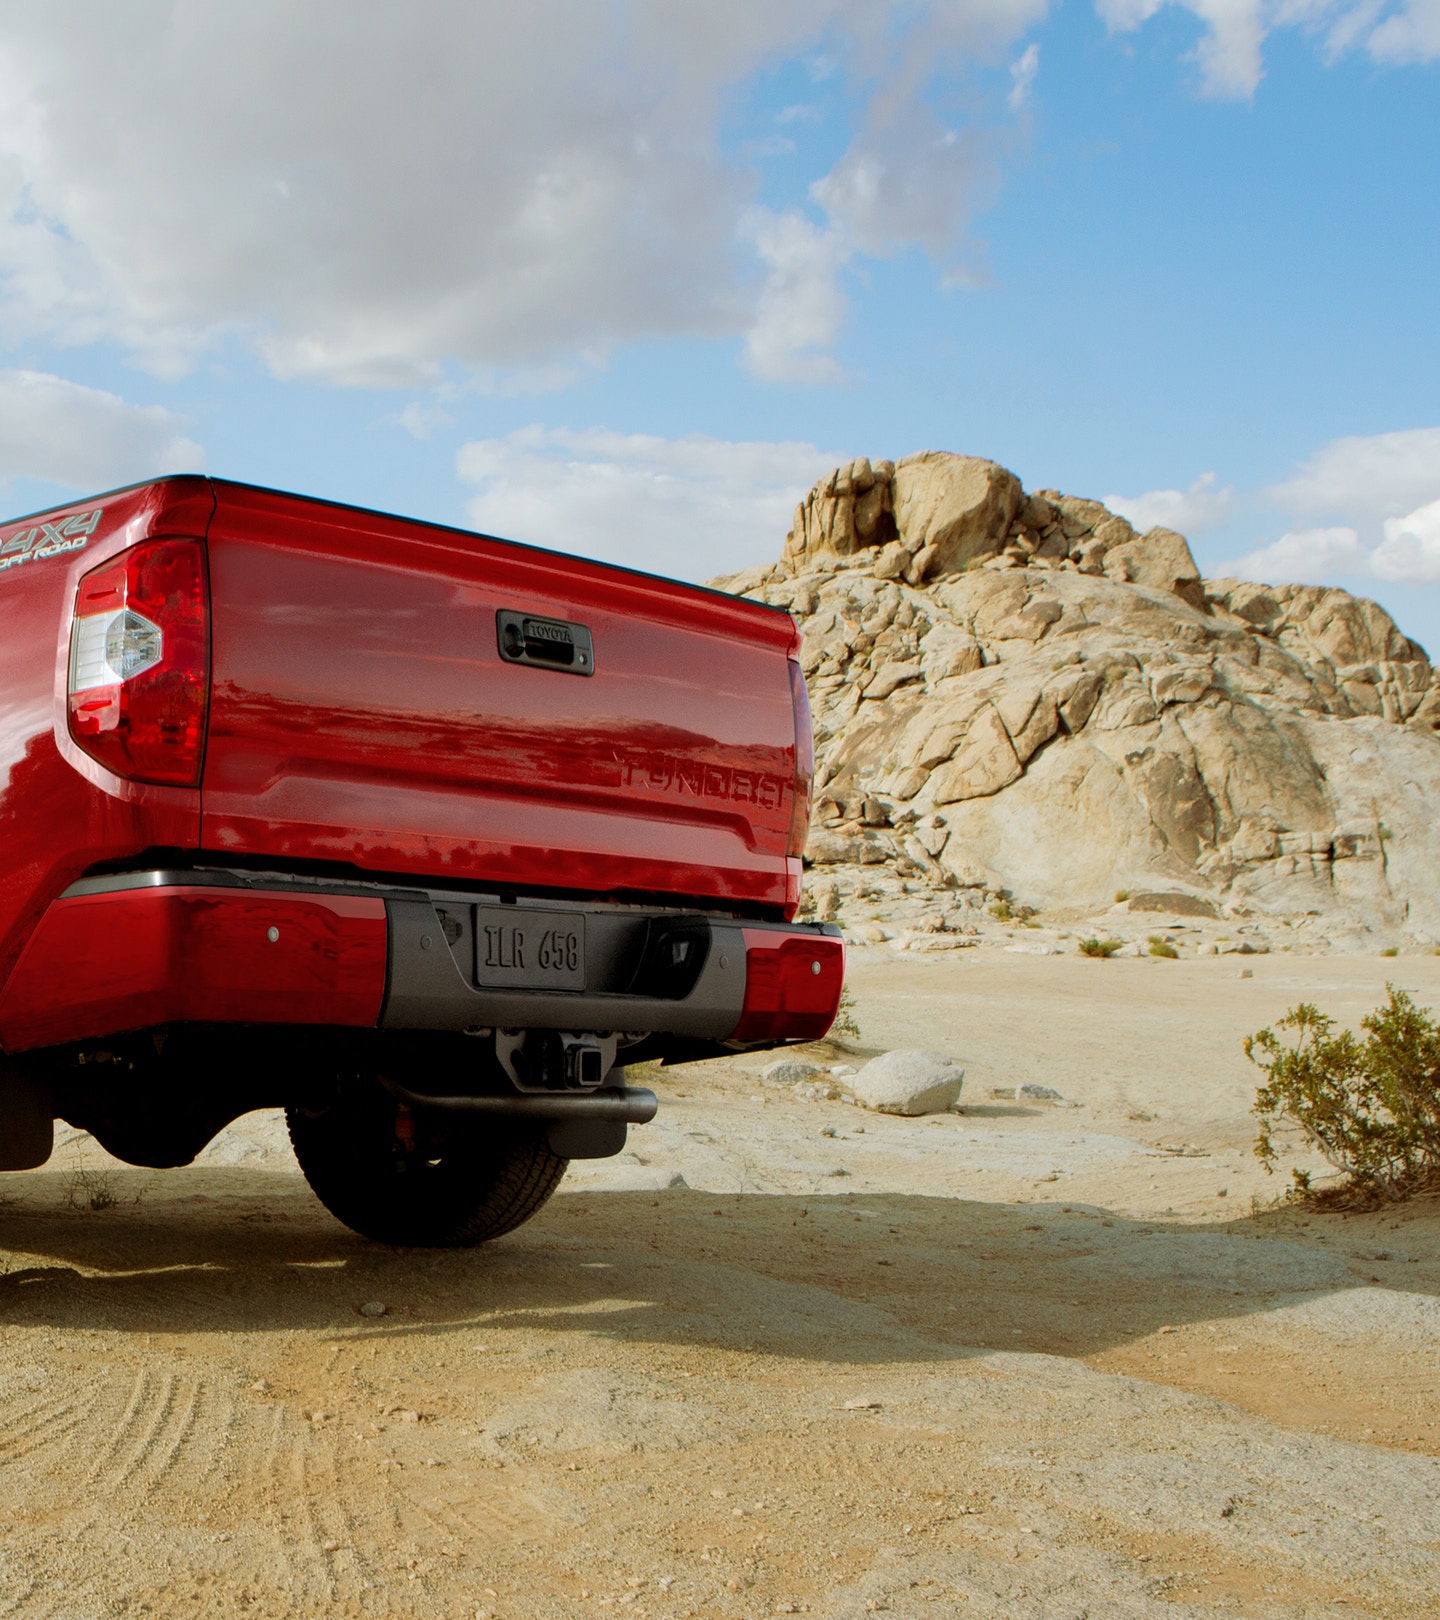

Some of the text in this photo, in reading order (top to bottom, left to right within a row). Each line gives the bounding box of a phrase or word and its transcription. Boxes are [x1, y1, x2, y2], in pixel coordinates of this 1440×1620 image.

[33, 536, 88, 560] ROAD
[530, 624, 573, 642] TOYOTA
[612, 750, 784, 811] TUNDRA
[538, 930, 579, 971] 658
